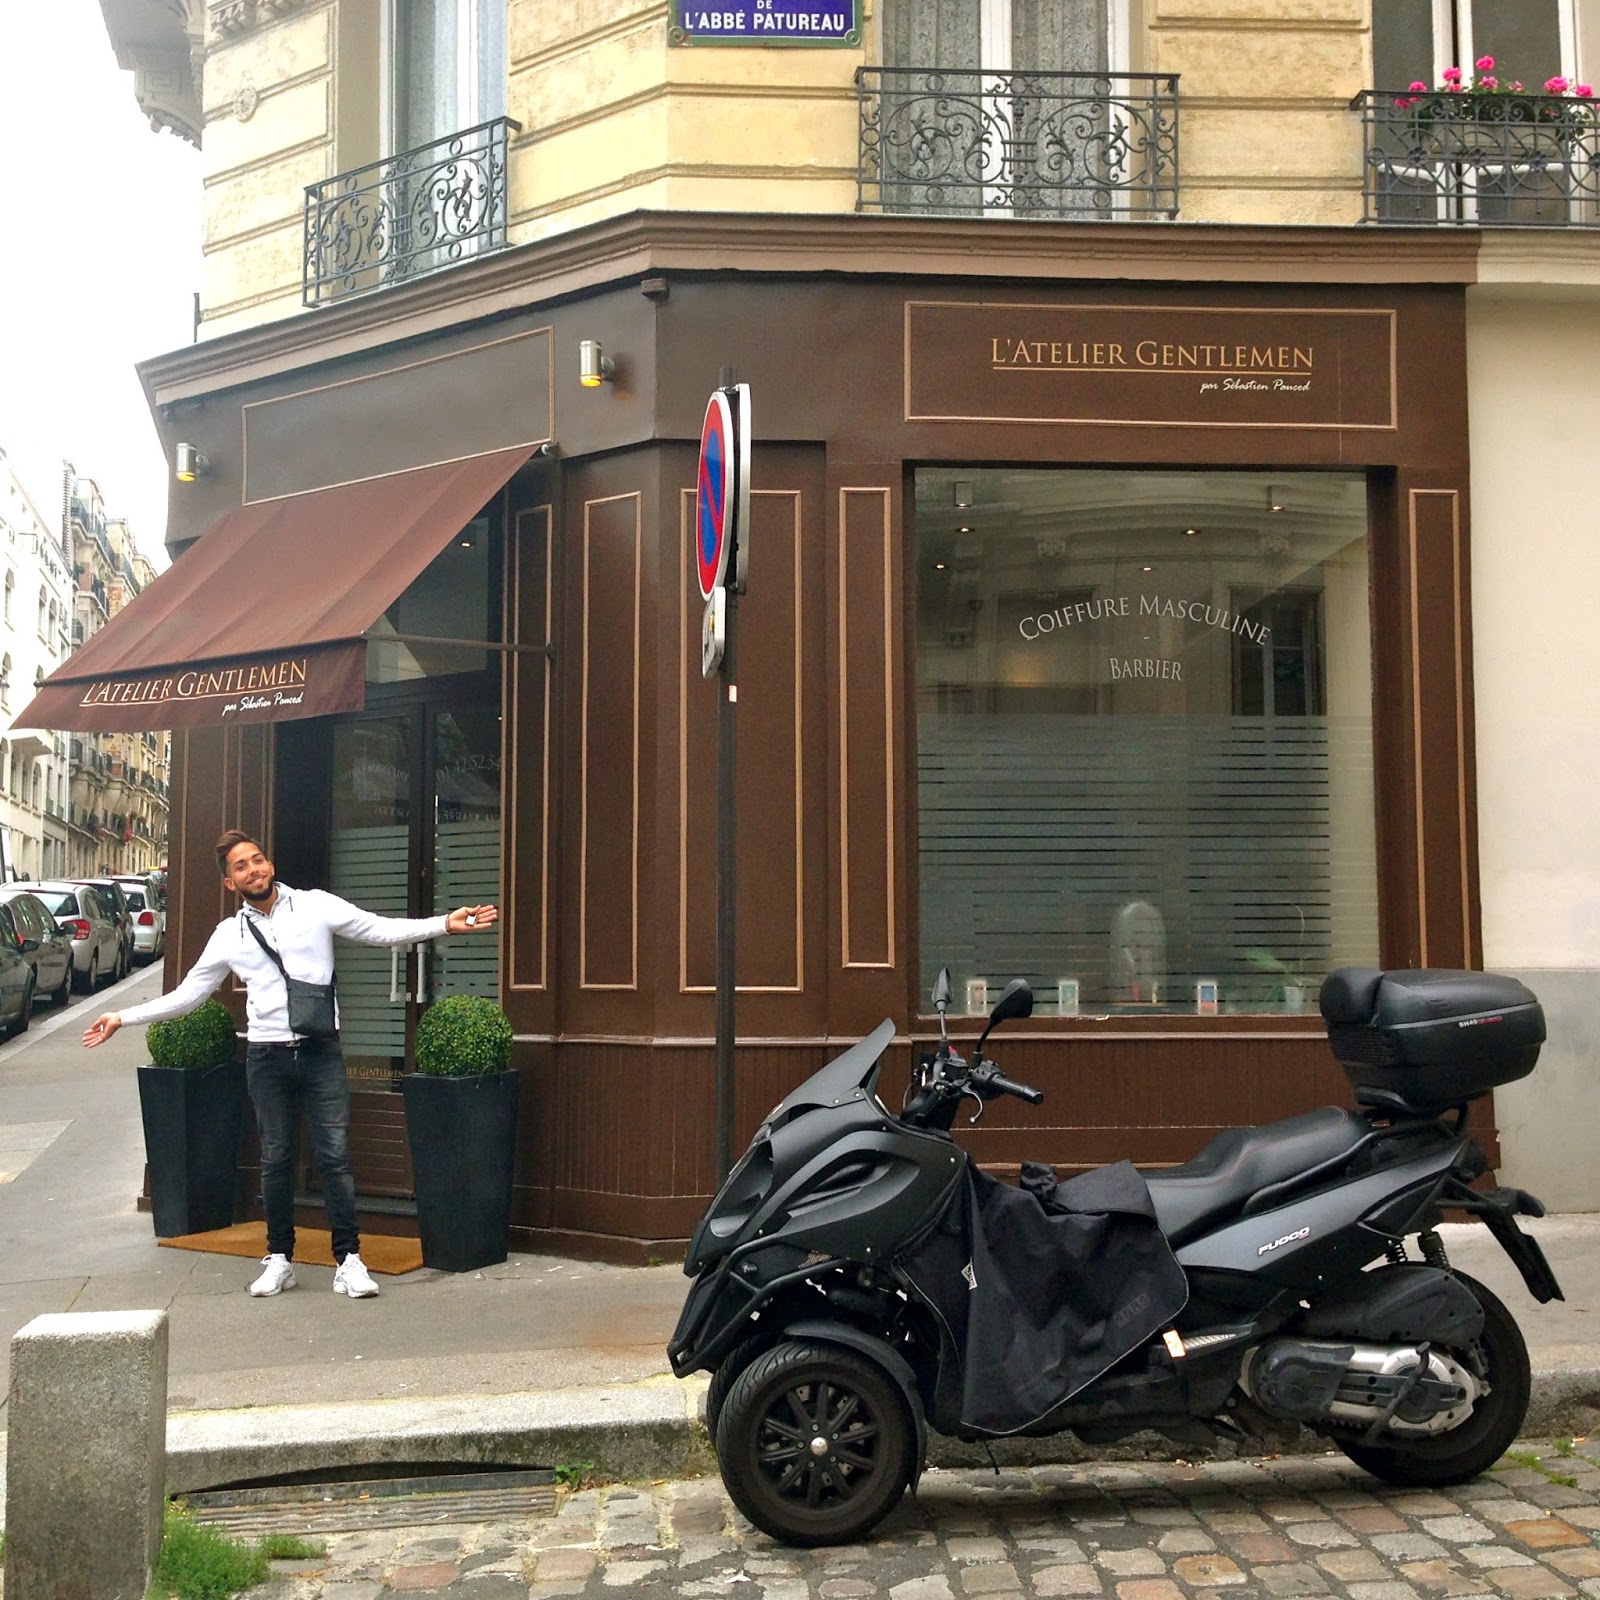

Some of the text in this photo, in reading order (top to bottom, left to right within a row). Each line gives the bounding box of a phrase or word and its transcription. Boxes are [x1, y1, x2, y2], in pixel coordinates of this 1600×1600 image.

[757, 0, 773, 9] DE
[684, 9, 845, 31] L'ABBÉ PATUREAU
[990, 338, 1314, 369] L'ATELIER GENTLEMEN
[1199, 382, 1219, 394] par
[1018, 594, 1272, 646] COIFFURE MASCULINE
[81, 659, 307, 704] L'ATELIER GENTLEMEN
[1109, 657, 1183, 681] BARBIER
[1258, 1226, 1310, 1256] FUOCO
